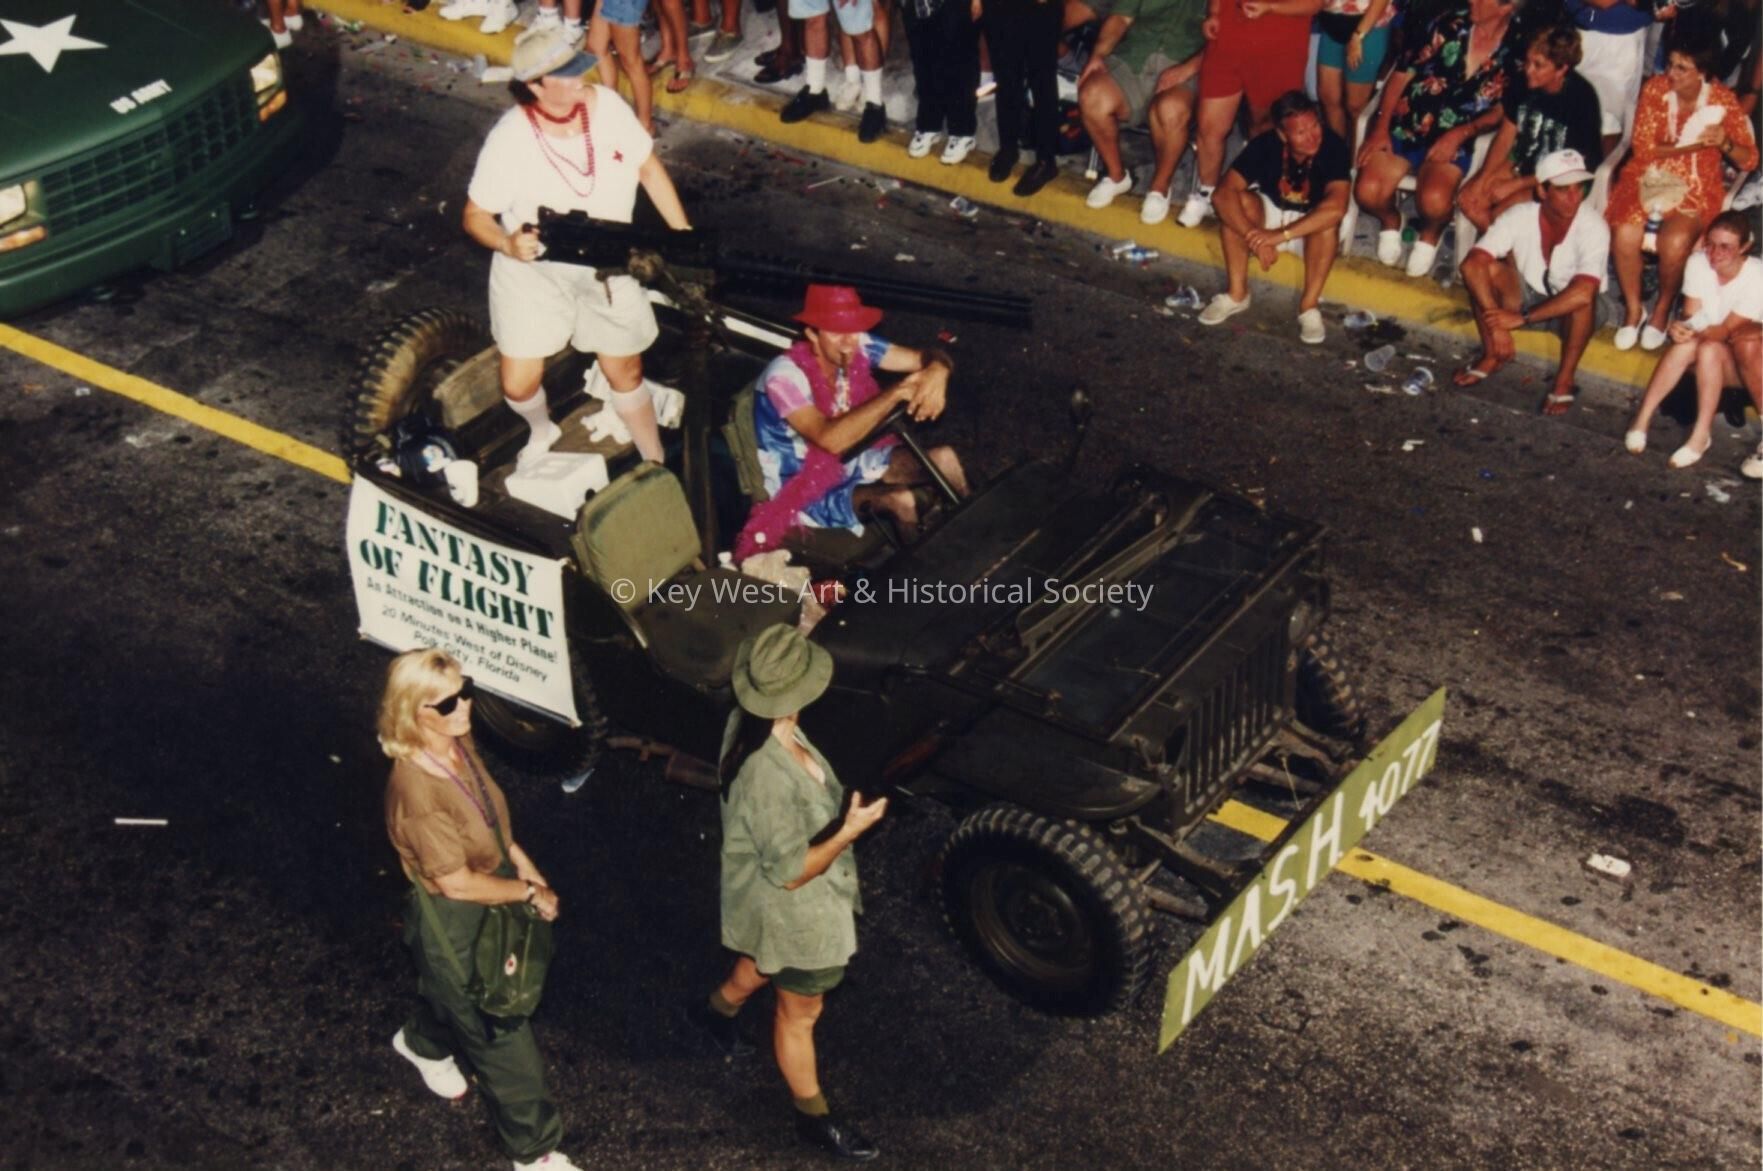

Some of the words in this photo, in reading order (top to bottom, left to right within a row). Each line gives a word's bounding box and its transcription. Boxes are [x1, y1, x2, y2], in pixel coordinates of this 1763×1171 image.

[359, 539, 403, 578] OF
[418, 560, 553, 638] FLIGHT
[375, 500, 535, 595] FANTASY
[386, 584, 444, 617] Attraction
[477, 619, 517, 646] Higher
[401, 612, 450, 640] Minutes
[455, 630, 486, 652] West
[490, 650, 502, 661] of
[506, 655, 547, 682] Disney
[478, 657, 520, 682] Florida
[1359, 718, 1441, 830] 4077
